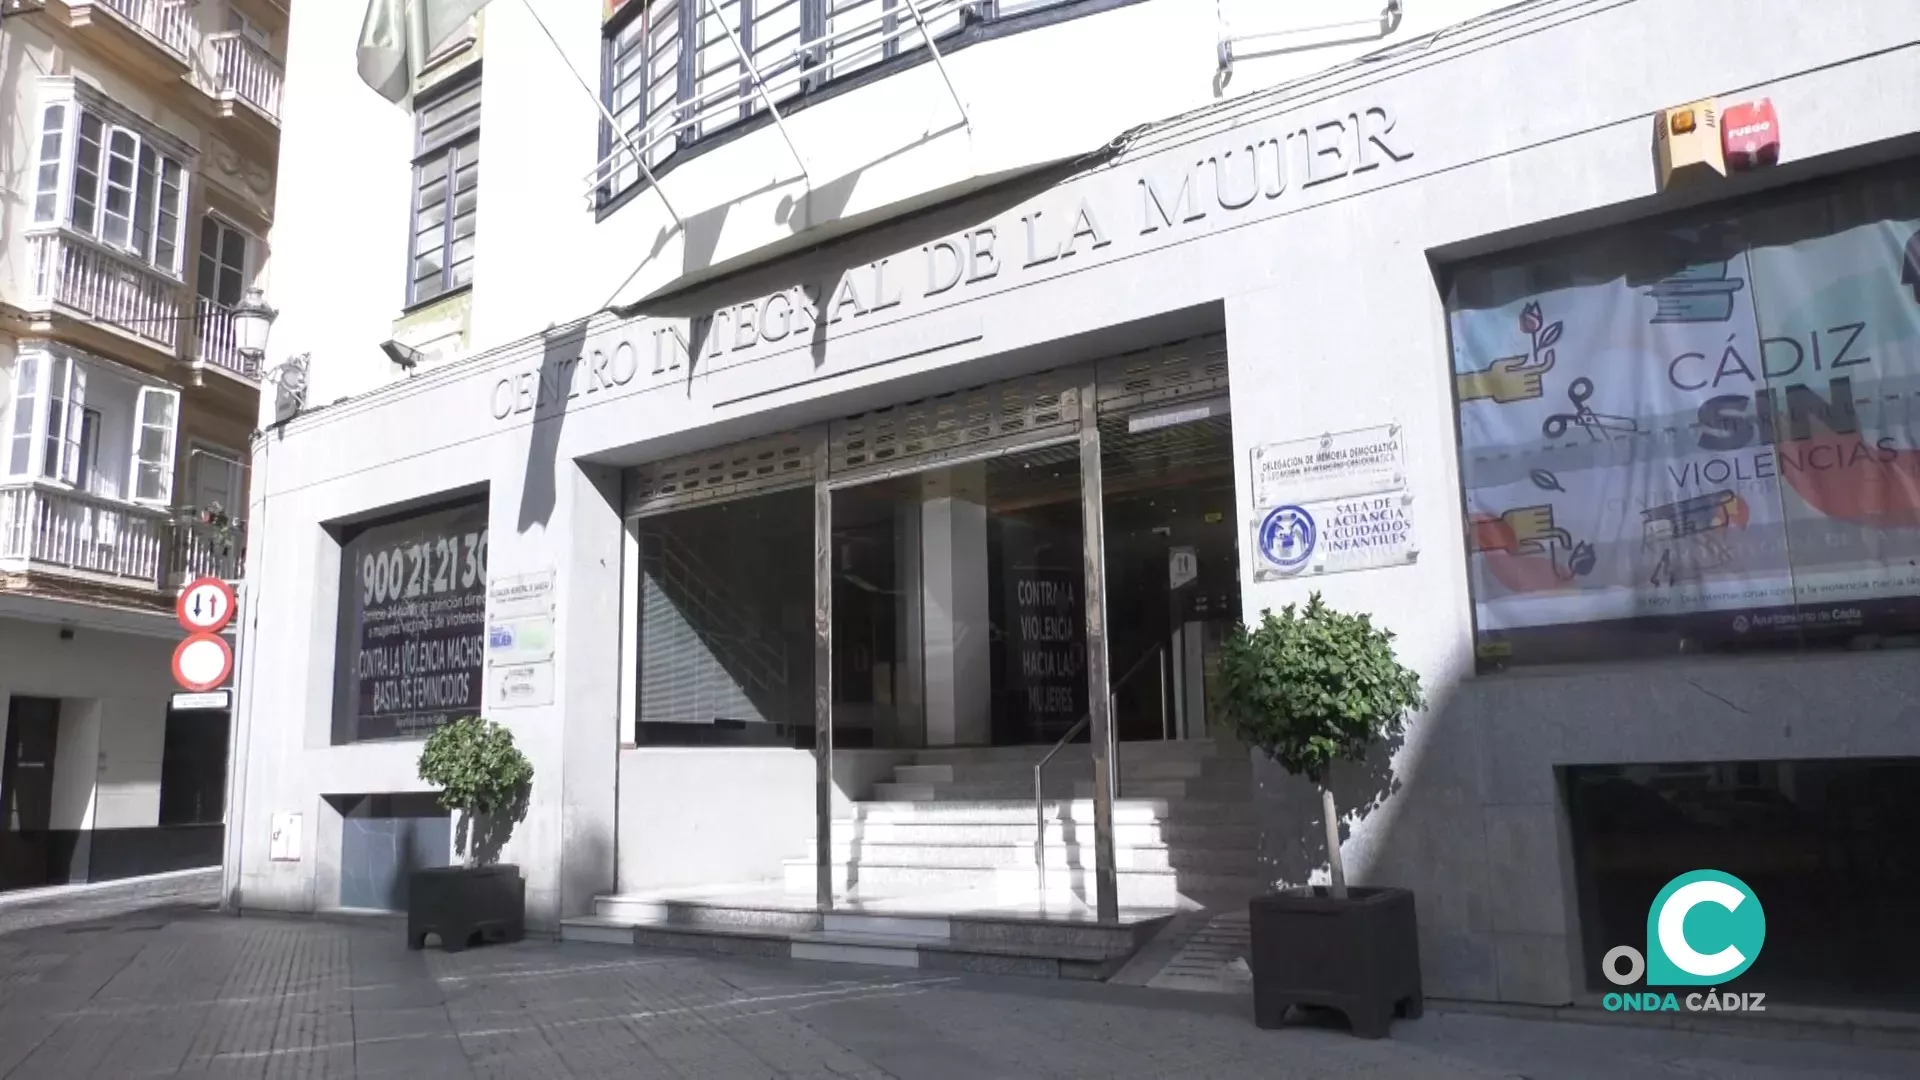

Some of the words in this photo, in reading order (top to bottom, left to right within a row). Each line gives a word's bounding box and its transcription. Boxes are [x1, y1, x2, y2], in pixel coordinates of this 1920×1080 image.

[1729, 121, 1770, 139] FUEGO
[489, 341, 638, 421] CENTRO
[651, 259, 901, 375] INTEGRAL
[923, 223, 1001, 298] DE
[1021, 197, 1112, 270] LA
[1139, 105, 1415, 236] MUJER
[1668, 321, 1872, 391] CÁDIZ
[1697, 375, 1858, 450] SIN
[1316, 450, 1347, 462] MEMORIA
[1668, 435, 1898, 488] VIOLENCIAS
[1326, 508, 1404, 528] LACTANCIA
[1336, 501, 1369, 514] SALA
[1374, 497, 1392, 510] DE
[1322, 530, 1329, 541] Y
[1334, 520, 1411, 539] CUIDADOS
[1328, 531, 1407, 552] INFANTILES
[363, 548, 404, 606] 900
[405, 541, 430, 598] 21
[433, 537, 458, 593] 21
[447, 609, 486, 626] violencia
[1020, 615, 1073, 640] VIOLENCIA
[359, 646, 389, 679] CONTRA
[389, 646, 400, 676] LA
[402, 639, 445, 675] VIOLENCIA
[1023, 650, 1056, 676] HACIA
[374, 680, 400, 715] BASTA
[401, 678, 412, 708] DE
[413, 673, 469, 708] FEMINICIDIOS
[1028, 685, 1074, 713] MUJERES
